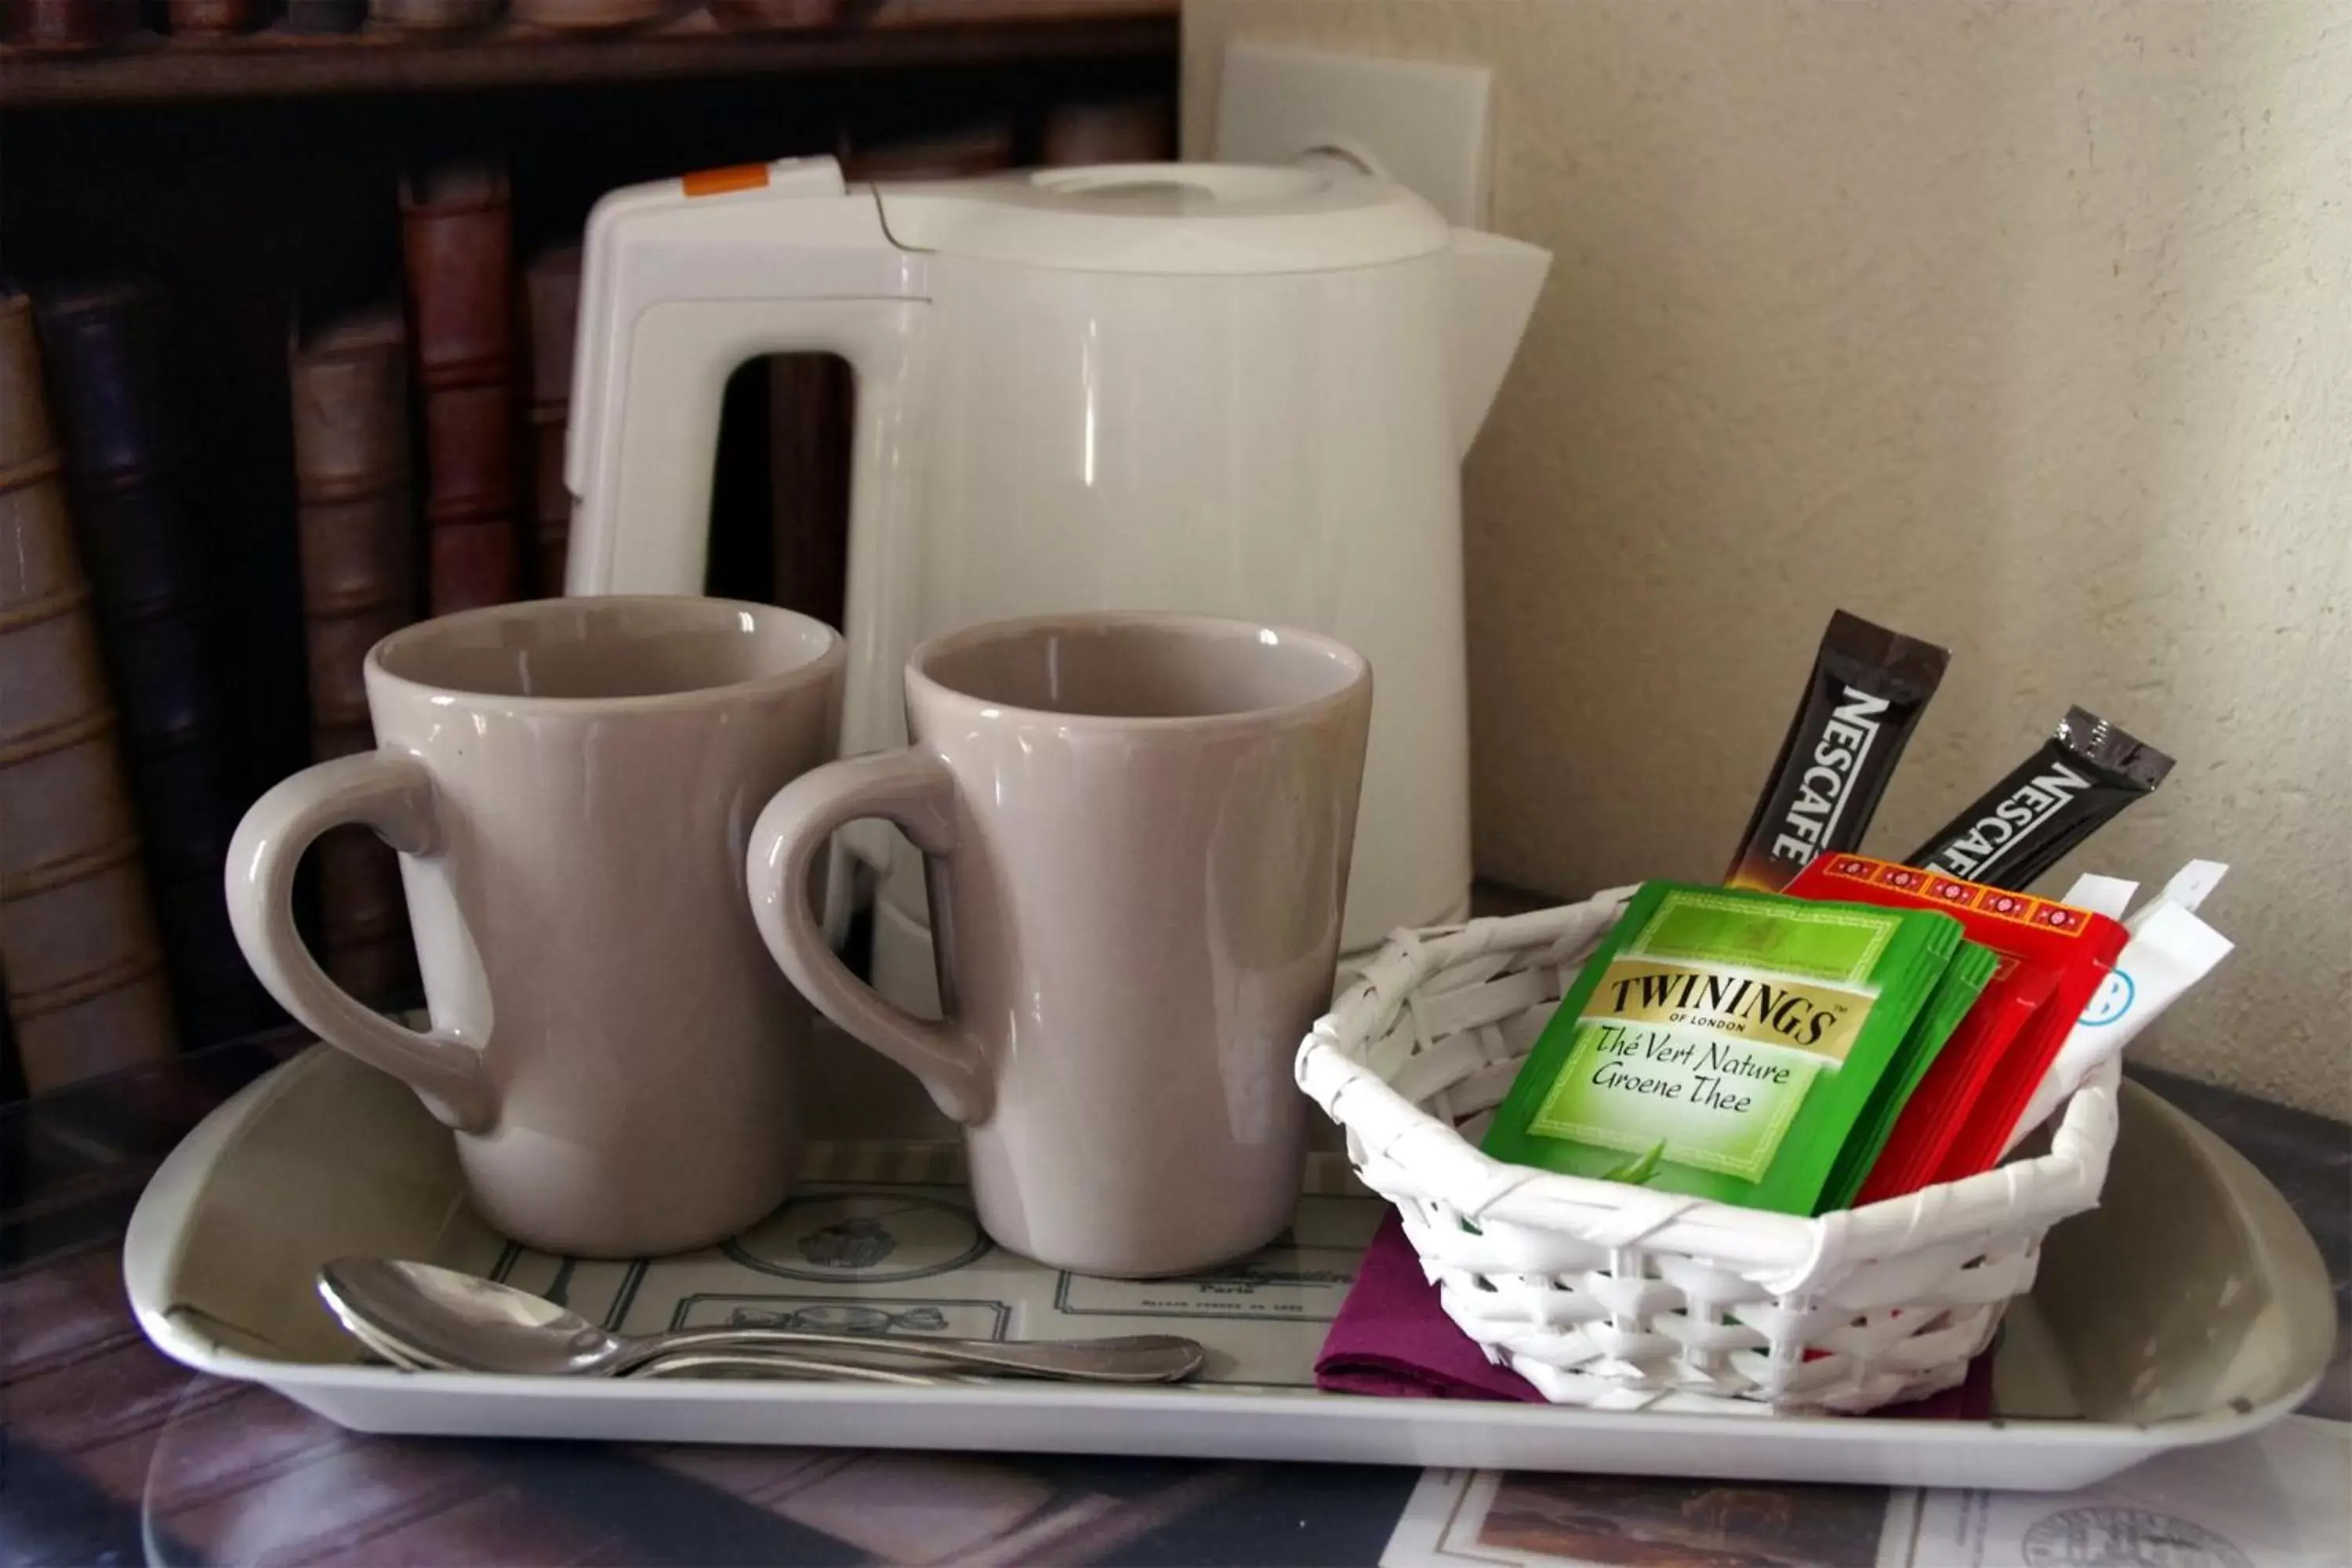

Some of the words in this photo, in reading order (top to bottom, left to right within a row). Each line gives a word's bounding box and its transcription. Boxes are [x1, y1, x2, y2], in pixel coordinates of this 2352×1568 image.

[1611, 974, 1837, 1046] TWININGS
[1668, 1012, 1685, 1023] OF
[1690, 1015, 1746, 1033] LONDON
[1595, 1025, 1643, 1057] Thé
[1645, 1031, 1694, 1065] Vert
[1693, 1041, 1791, 1085] Nature
[1592, 1061, 1682, 1098] Groene
[1689, 1074, 1751, 1113] Thee
